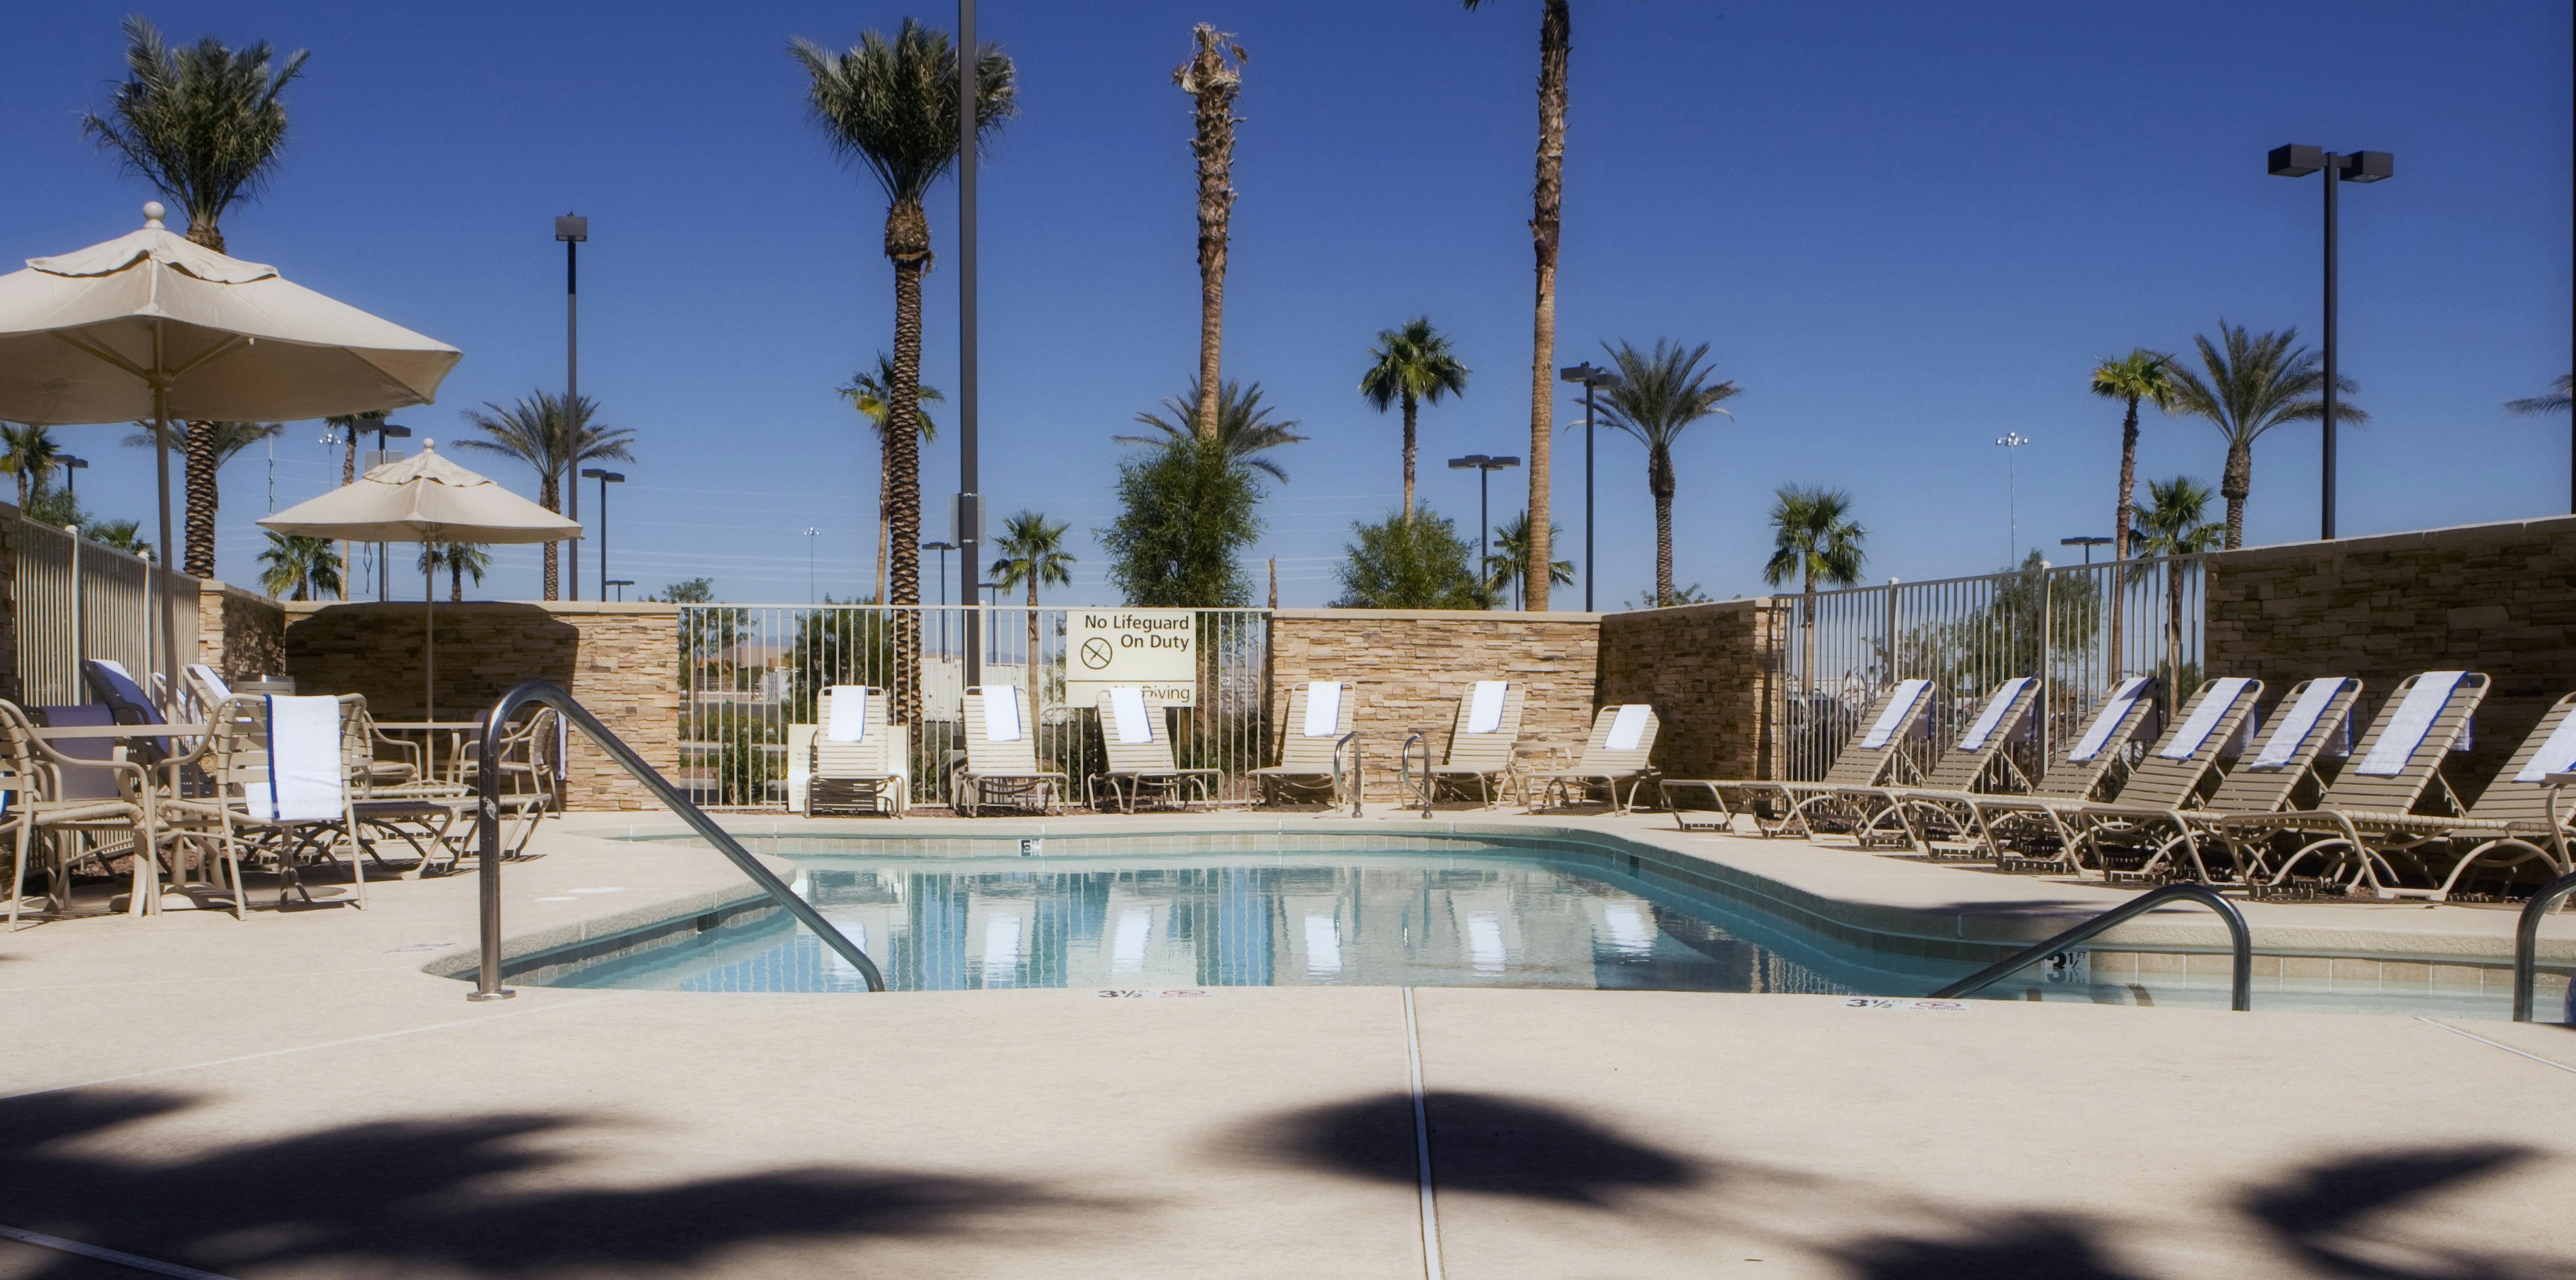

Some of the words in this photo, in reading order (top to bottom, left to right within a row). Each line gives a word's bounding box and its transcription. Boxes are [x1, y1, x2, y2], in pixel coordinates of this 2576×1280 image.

[1085, 615, 1107, 629] No
[1113, 615, 1189, 633] Lifeguard
[1121, 634, 1144, 648] On
[1150, 634, 1189, 652] Duty
[2078, 951, 2087, 959] FT
